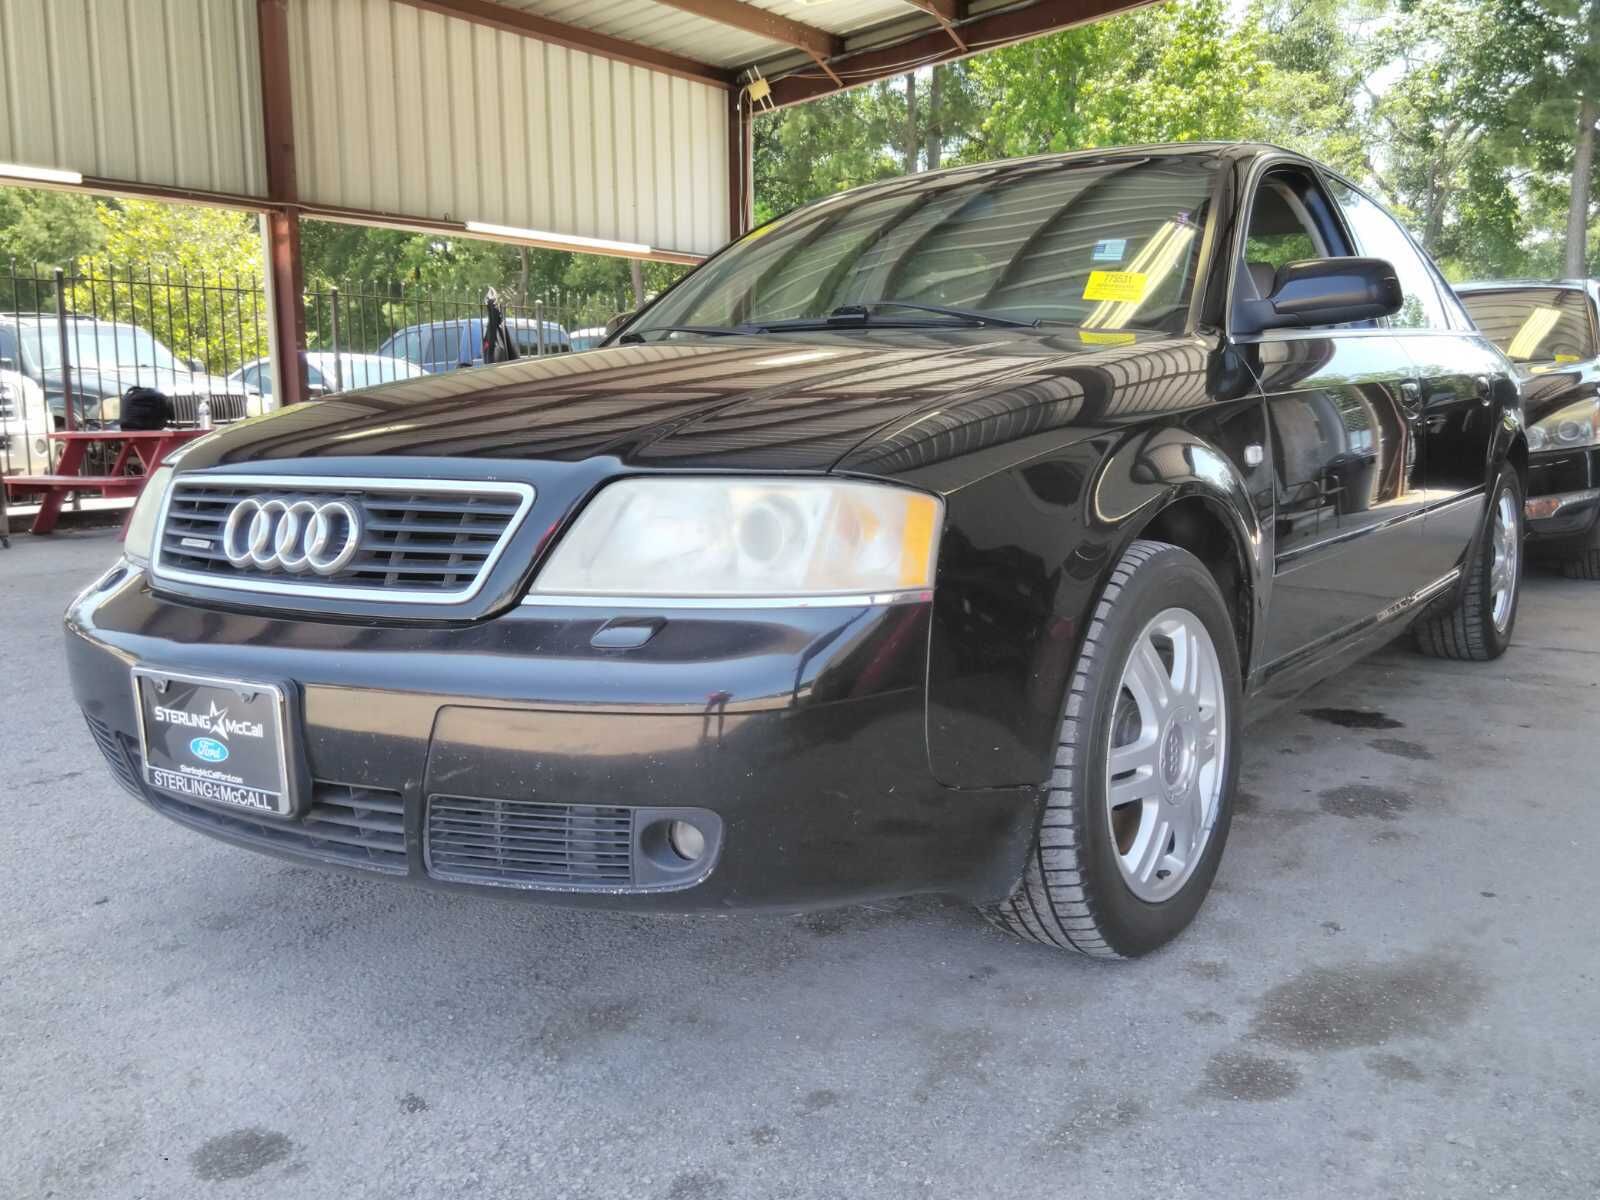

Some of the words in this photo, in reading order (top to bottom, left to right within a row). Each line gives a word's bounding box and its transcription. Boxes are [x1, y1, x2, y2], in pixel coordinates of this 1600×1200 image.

[154, 706, 210, 729] STERLING
[225, 718, 264, 737] McCall
[154, 771, 213, 797] STERLING
[220, 786, 272, 809] McCALL
